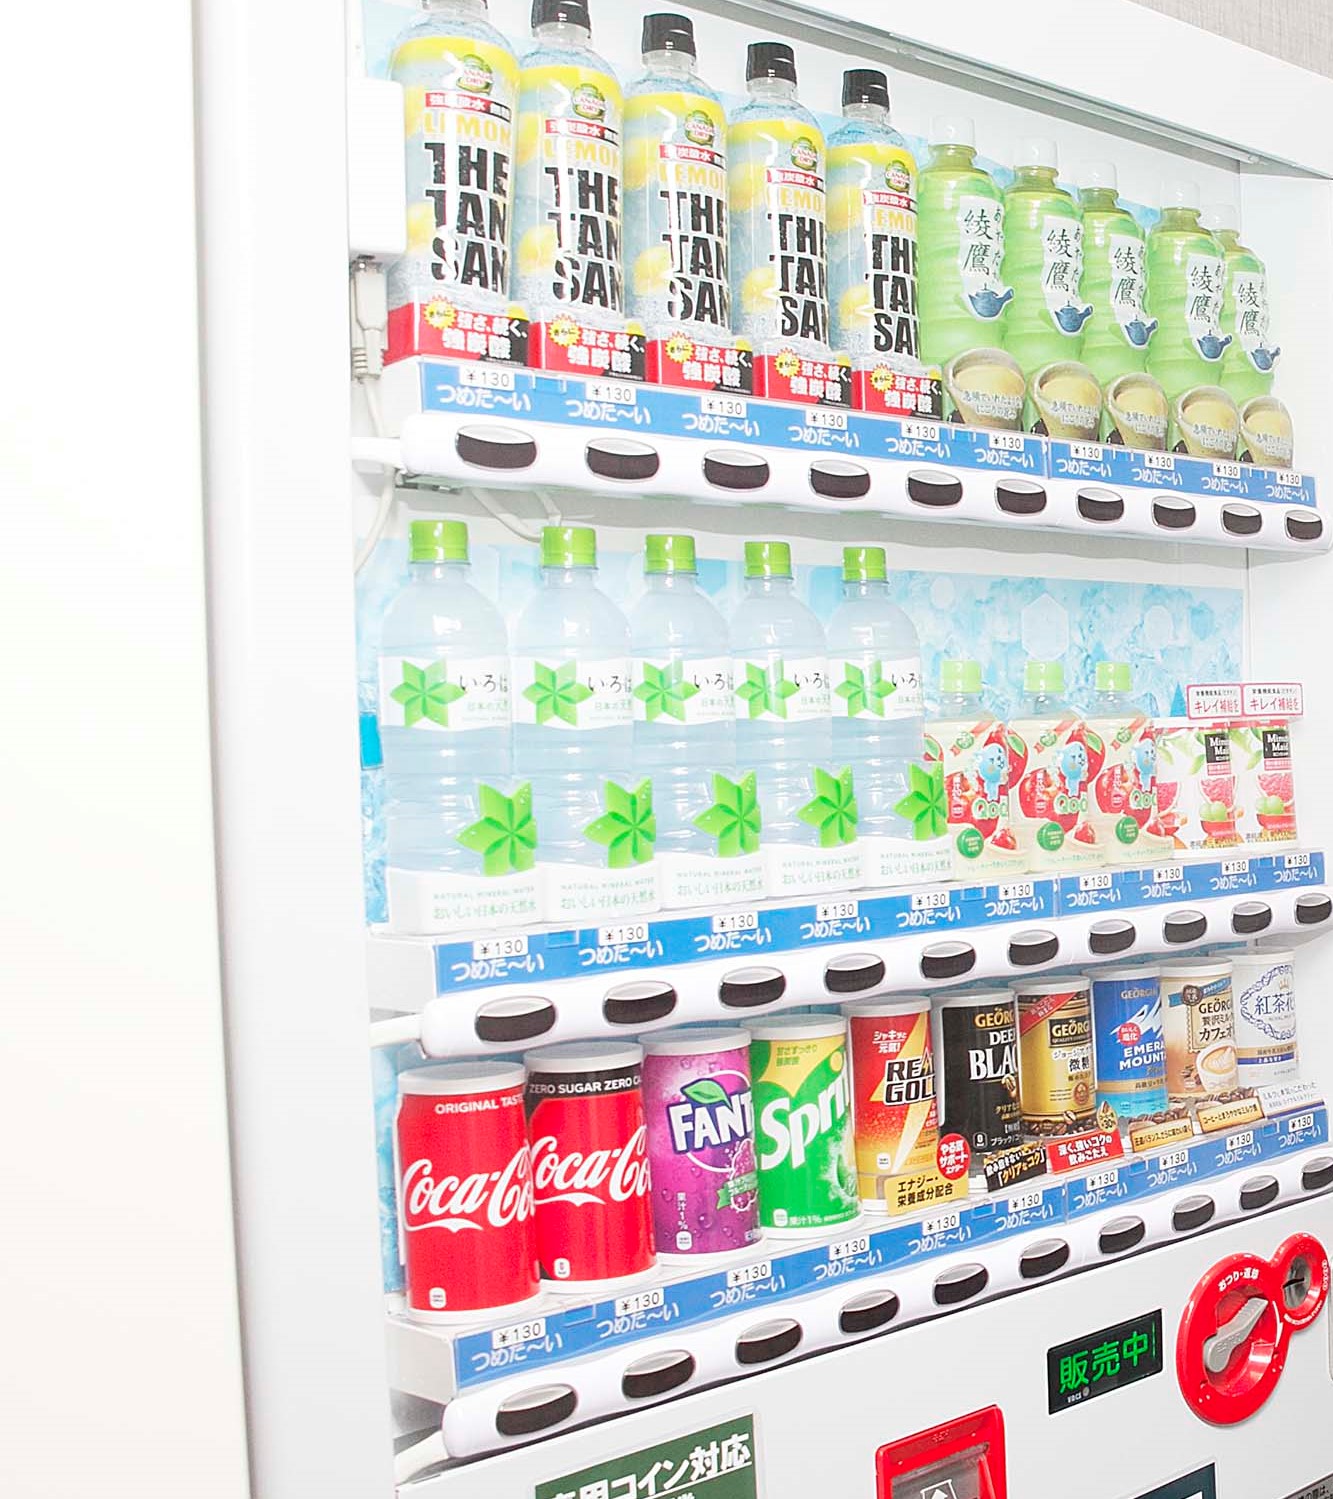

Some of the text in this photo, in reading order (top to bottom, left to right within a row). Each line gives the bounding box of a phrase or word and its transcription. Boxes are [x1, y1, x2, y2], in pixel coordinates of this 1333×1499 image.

[964, 208, 993, 275] 綾鷹
[1047, 228, 1073, 292] 綾鷹
[1114, 246, 1137, 307] 綾鷹
[1190, 265, 1213, 323] 綾鷹
[467, 369, 510, 388] ¥130
[593, 385, 632, 402] ¥130
[707, 401, 742, 415] ¥130
[812, 413, 844, 427] ¥130
[822, 903, 855, 918] ¥130
[717, 914, 754, 930] ¥130
[604, 925, 645, 942] ¥130
[479, 938, 523, 956] ¥130
[529, 1085, 555, 1094] ZERO
[558, 1082, 601, 1094] SUGAR
[604, 1078, 632, 1090] ZERO
[435, 1099, 498, 1114] ORIGINAL
[897, 1182, 953, 1207] 栄養成分配合
[833, 1238, 867, 1257] ¥130
[732, 1263, 769, 1284] ¥130
[621, 1291, 661, 1313] ¥130
[498, 1321, 543, 1346] ¥130
[1059, 1331, 1148, 1393] 販売中
